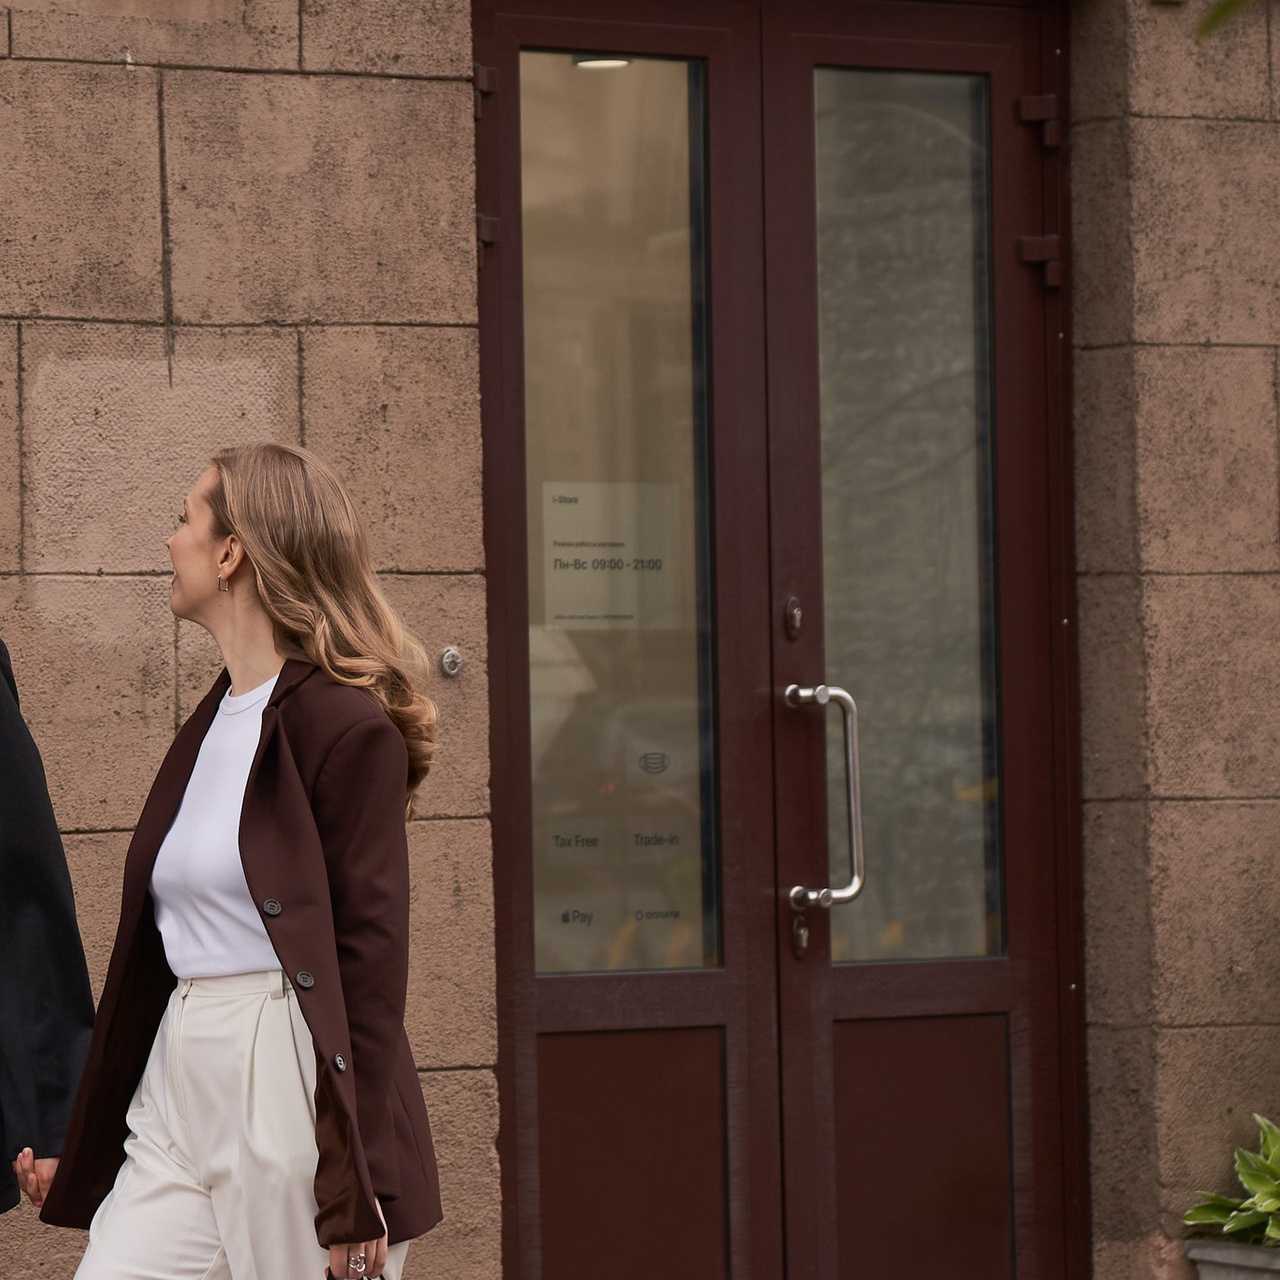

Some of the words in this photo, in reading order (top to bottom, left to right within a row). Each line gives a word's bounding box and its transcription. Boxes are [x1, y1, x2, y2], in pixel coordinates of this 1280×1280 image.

[554, 558, 588, 570] Пн-Вс
[592, 558, 624, 571] 09:00
[633, 558, 662, 570] 21:00
[553, 835, 572, 848] Tax
[574, 835, 599, 847] Free
[634, 833, 679, 846] Trade-in
[571, 909, 594, 926] Pay
